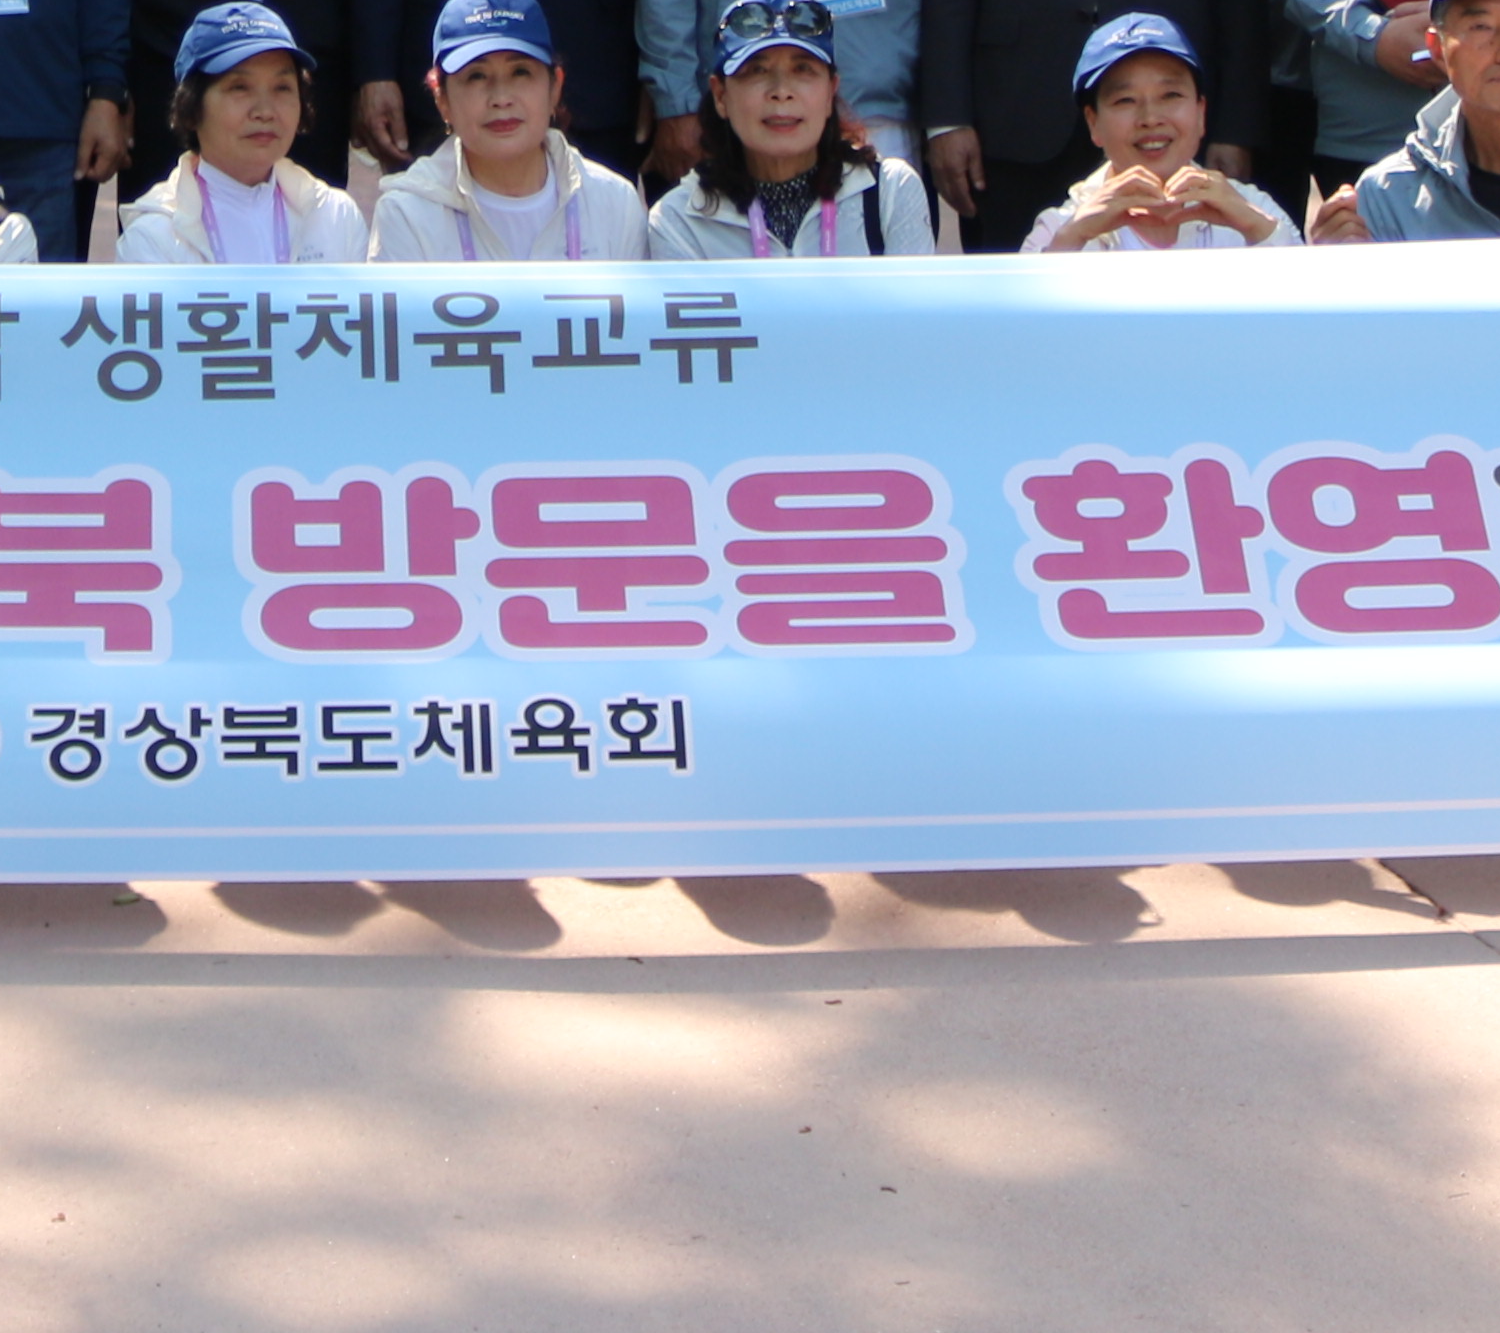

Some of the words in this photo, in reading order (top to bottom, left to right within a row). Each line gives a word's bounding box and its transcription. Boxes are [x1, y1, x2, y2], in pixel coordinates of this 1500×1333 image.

[61, 290, 758, 401] 생활체육교류
[250, 469, 966, 651] 방문을
[30, 697, 690, 782] 경상북도체육회
